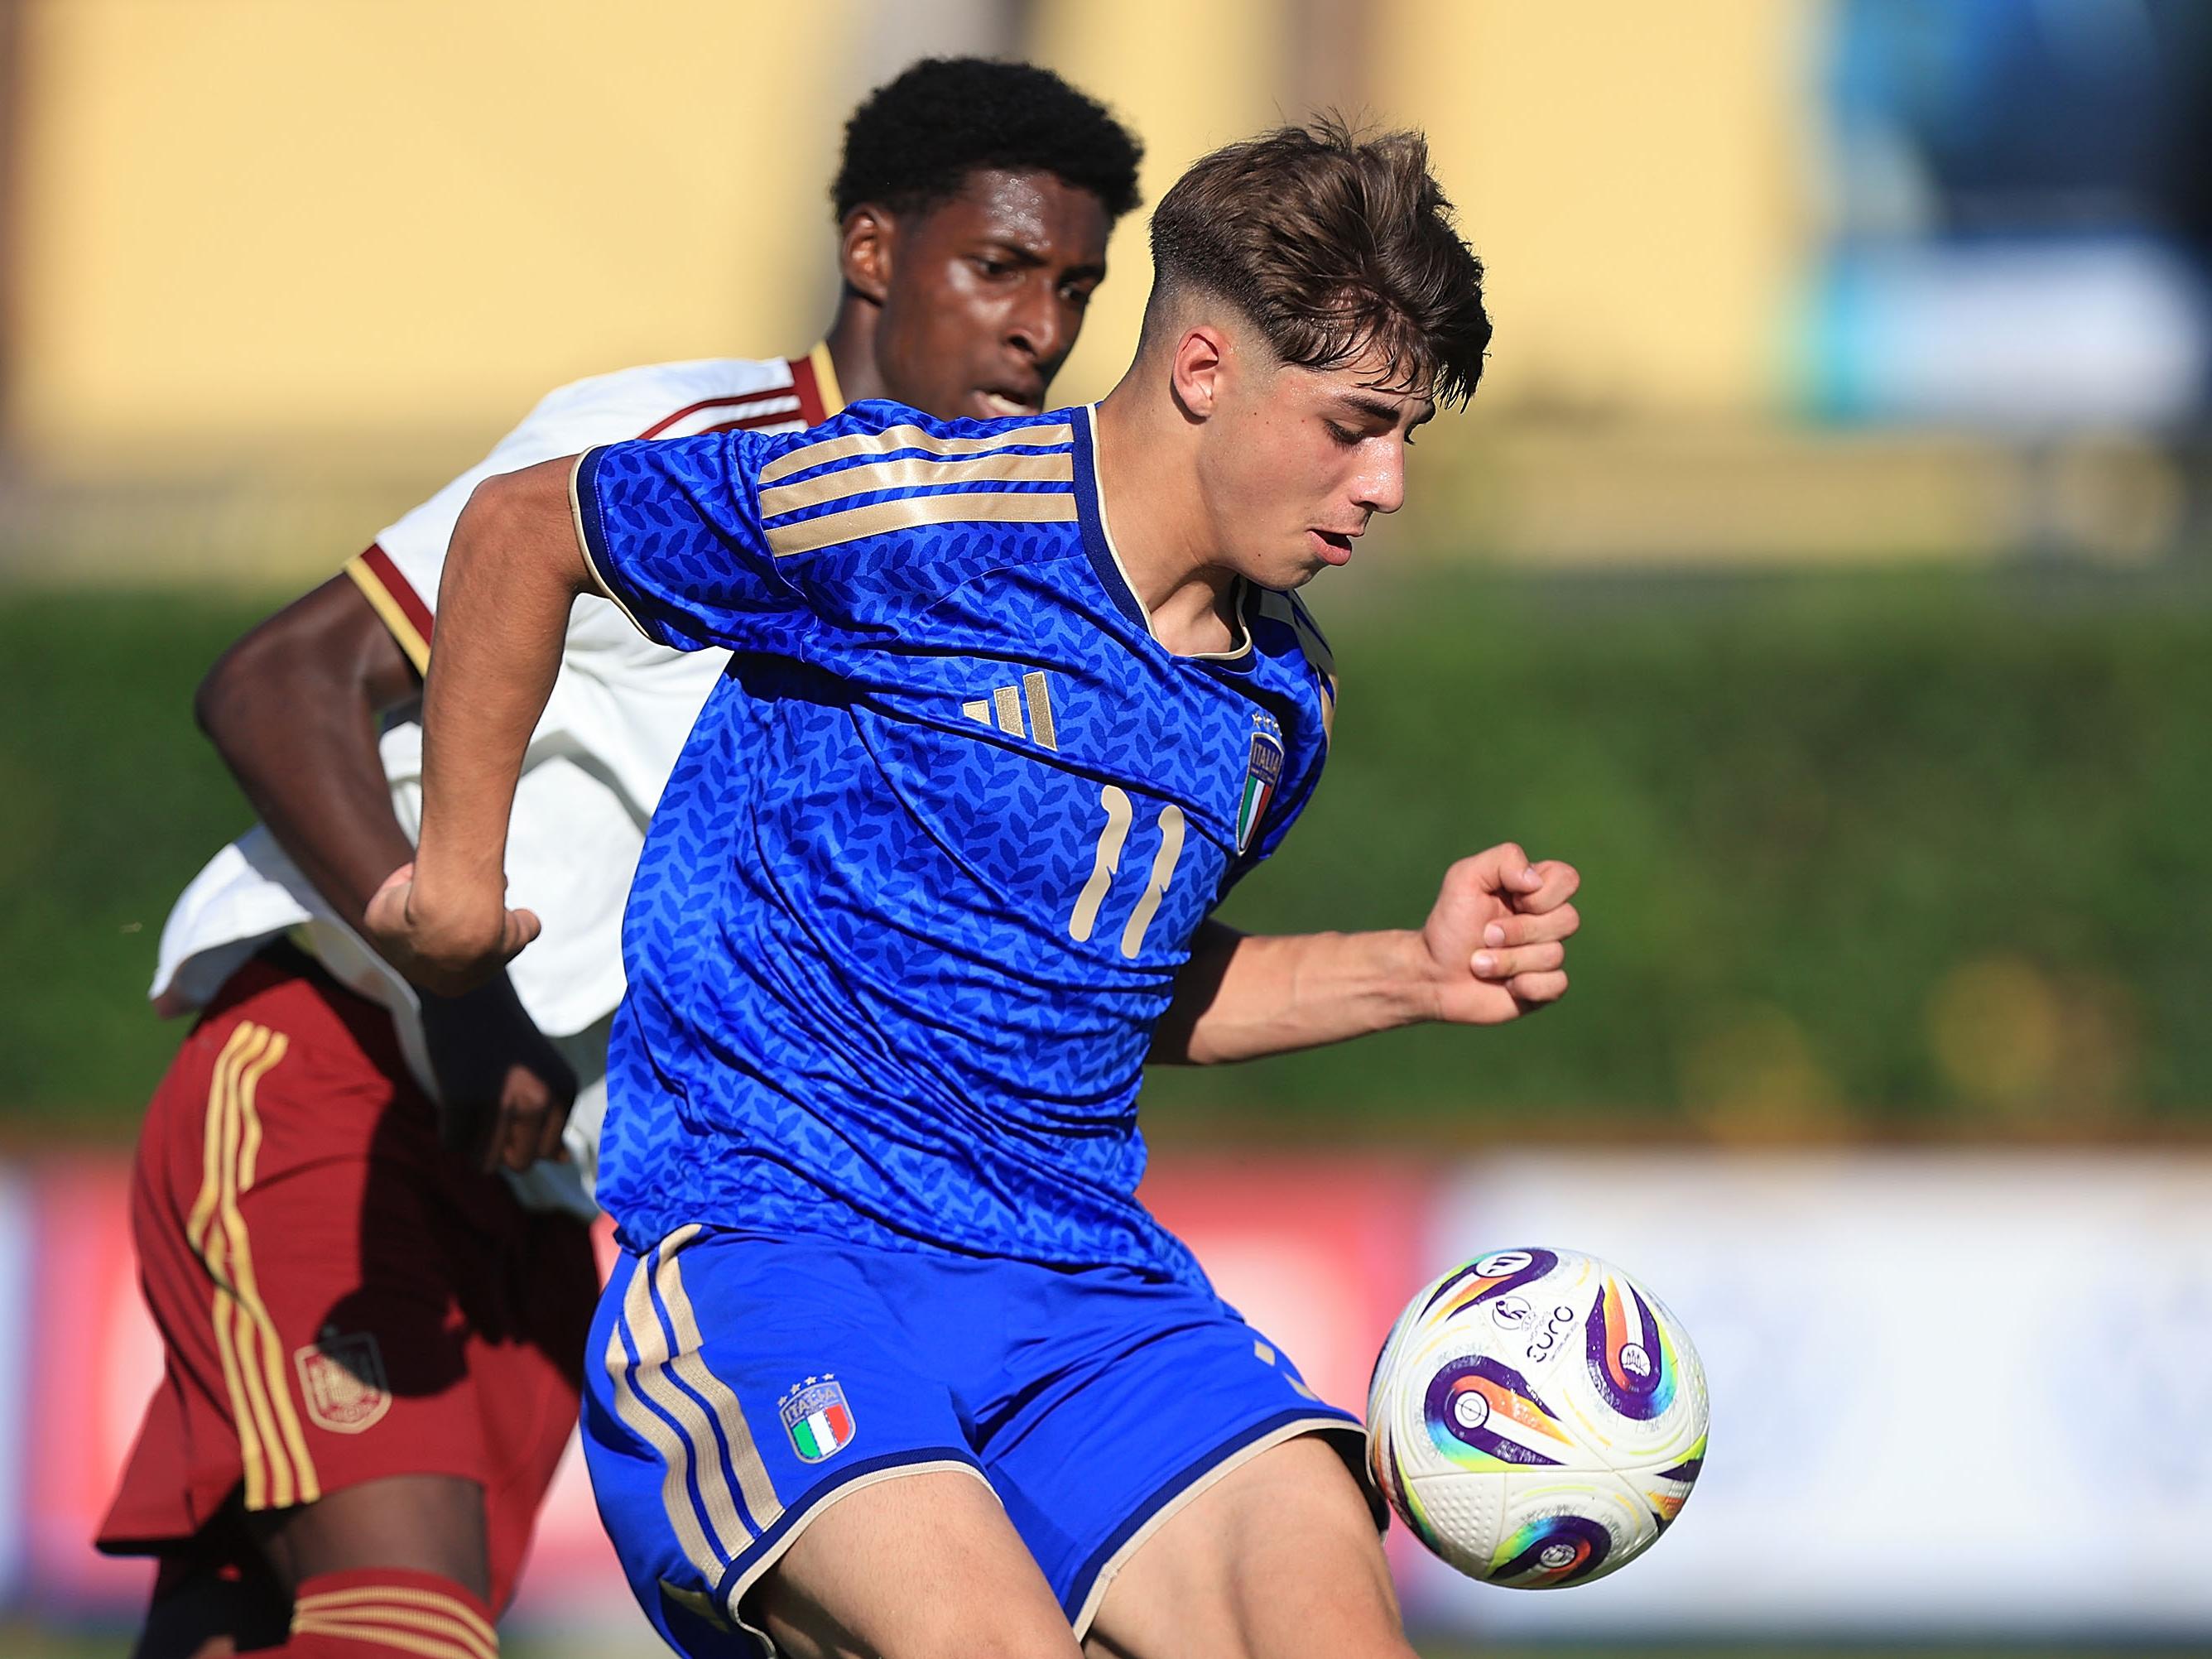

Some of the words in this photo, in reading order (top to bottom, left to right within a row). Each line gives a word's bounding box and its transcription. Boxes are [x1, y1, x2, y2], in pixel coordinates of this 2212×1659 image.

[1252, 742, 1280, 773] ITALIA
[1068, 784, 1185, 959] 11
[785, 1387, 837, 1422] ITALIA
